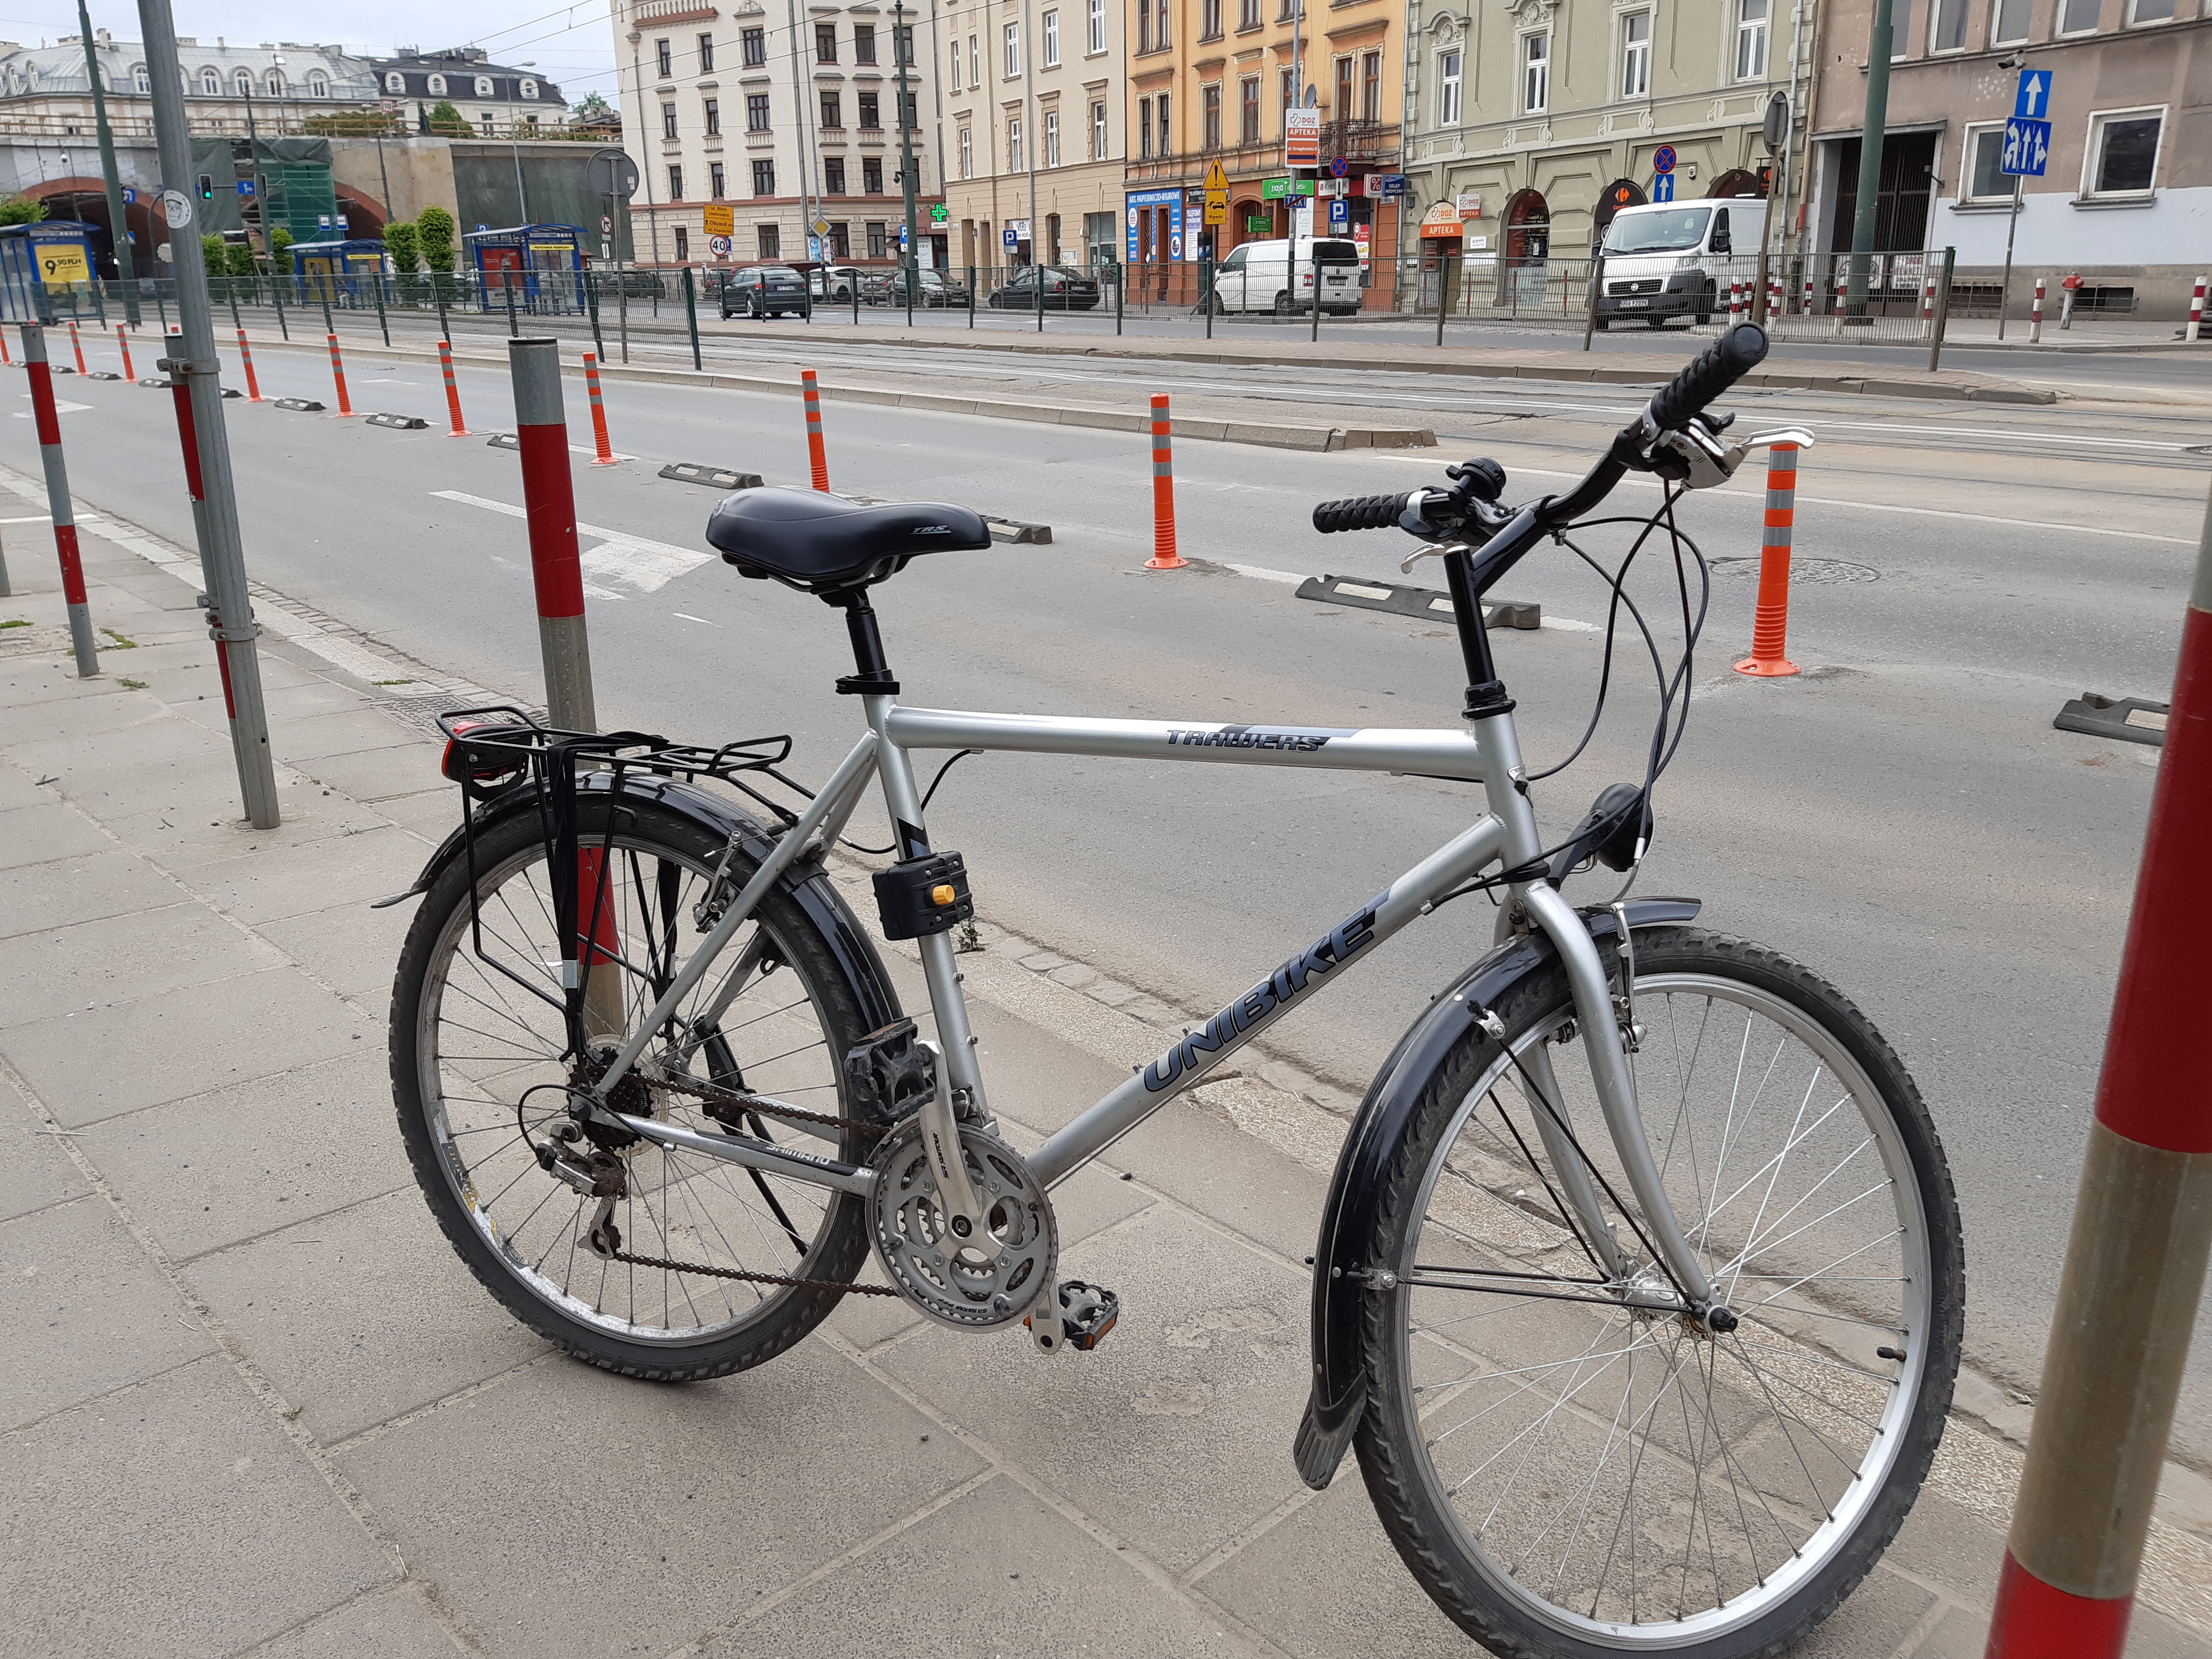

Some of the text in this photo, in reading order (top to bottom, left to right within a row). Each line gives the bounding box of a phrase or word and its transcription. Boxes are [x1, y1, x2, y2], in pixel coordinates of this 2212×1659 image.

[1271, 185, 1284, 193] ziaja
[1286, 195, 1306, 207] TAXI
[1333, 203, 1344, 220] P
[1429, 226, 1454, 235] APTEKA
[1006, 232, 1014, 244] P
[712, 240, 725, 251] 40
[1199, 248, 1202, 256] P
[912, 525, 948, 533] TRS
[1167, 730, 1321, 752] TRAWERS
[1144, 906, 1375, 1092] UNIBIKE
[766, 1144, 830, 1165] SHIMANO
